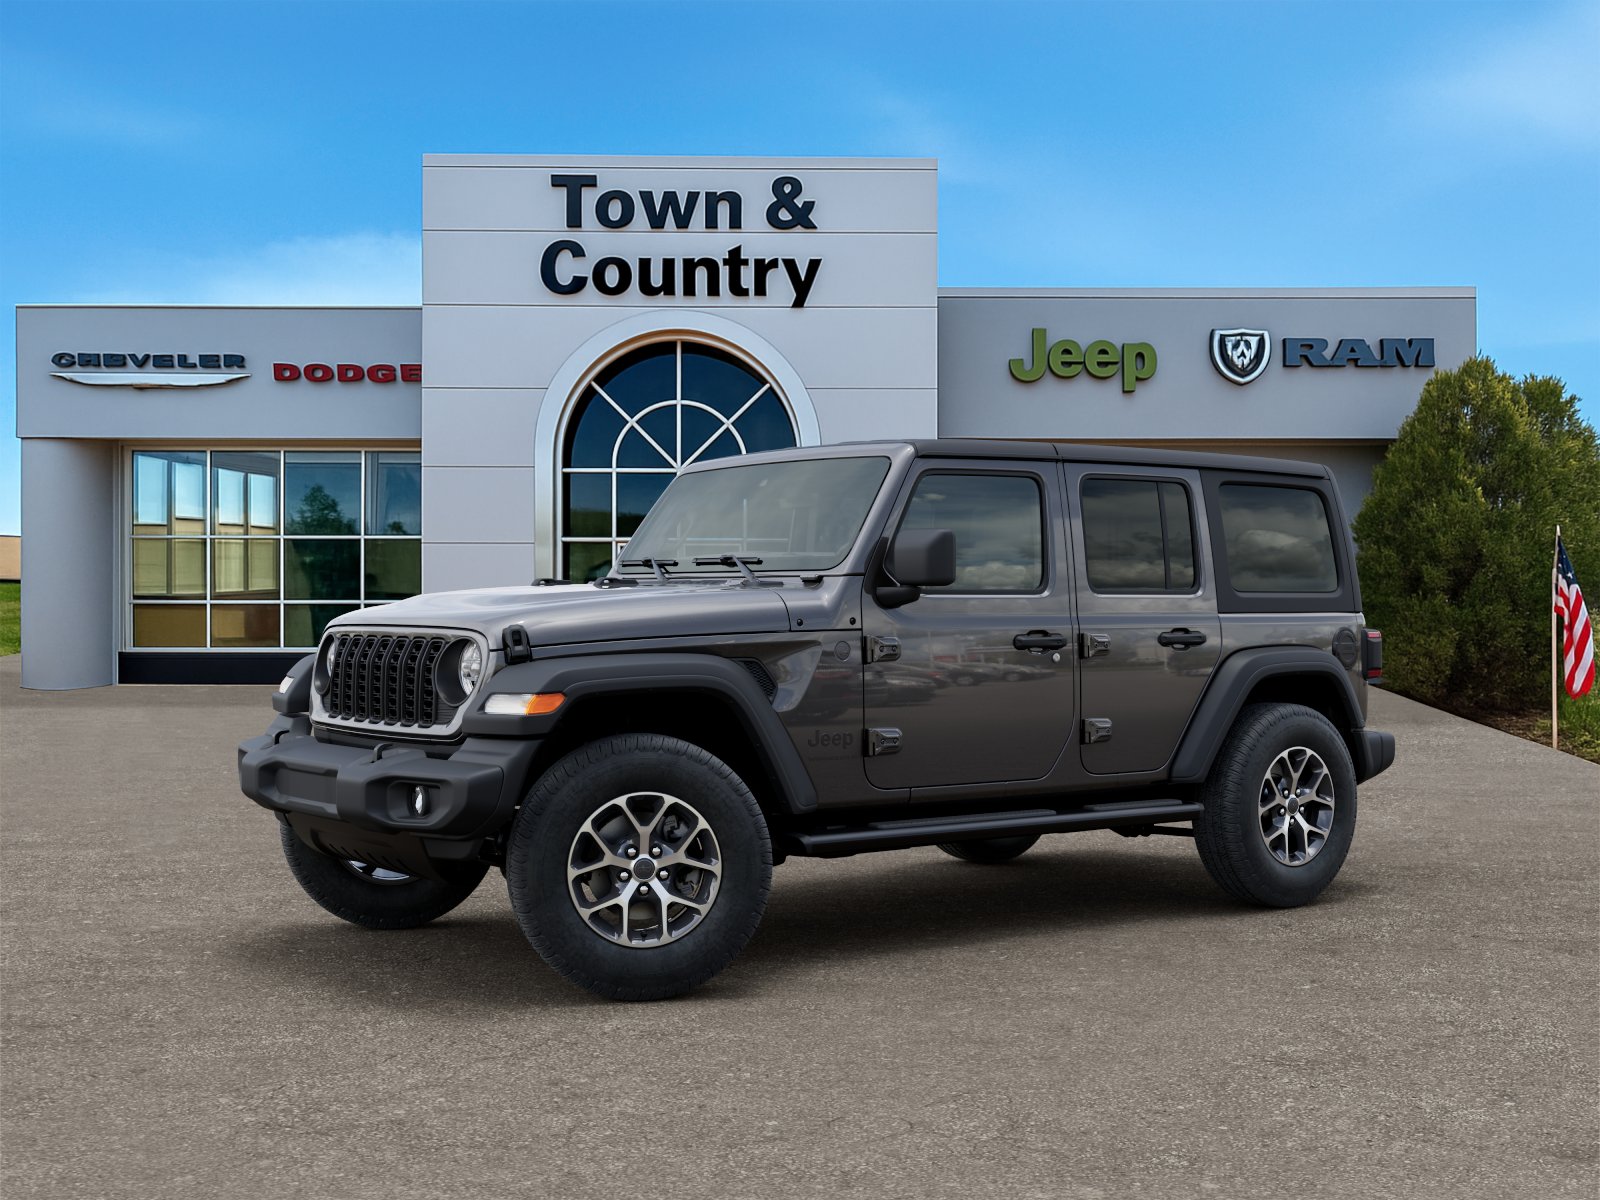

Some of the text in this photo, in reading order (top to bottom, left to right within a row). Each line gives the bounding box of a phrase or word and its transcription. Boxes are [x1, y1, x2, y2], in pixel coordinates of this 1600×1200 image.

[550, 173, 818, 230] Town &
[540, 239, 823, 308] Country
[272, 362, 422, 383] DODGE
[1008, 327, 1158, 392] Jeep
[1282, 336, 1436, 368] RAM
[807, 729, 854, 750] Jeep
